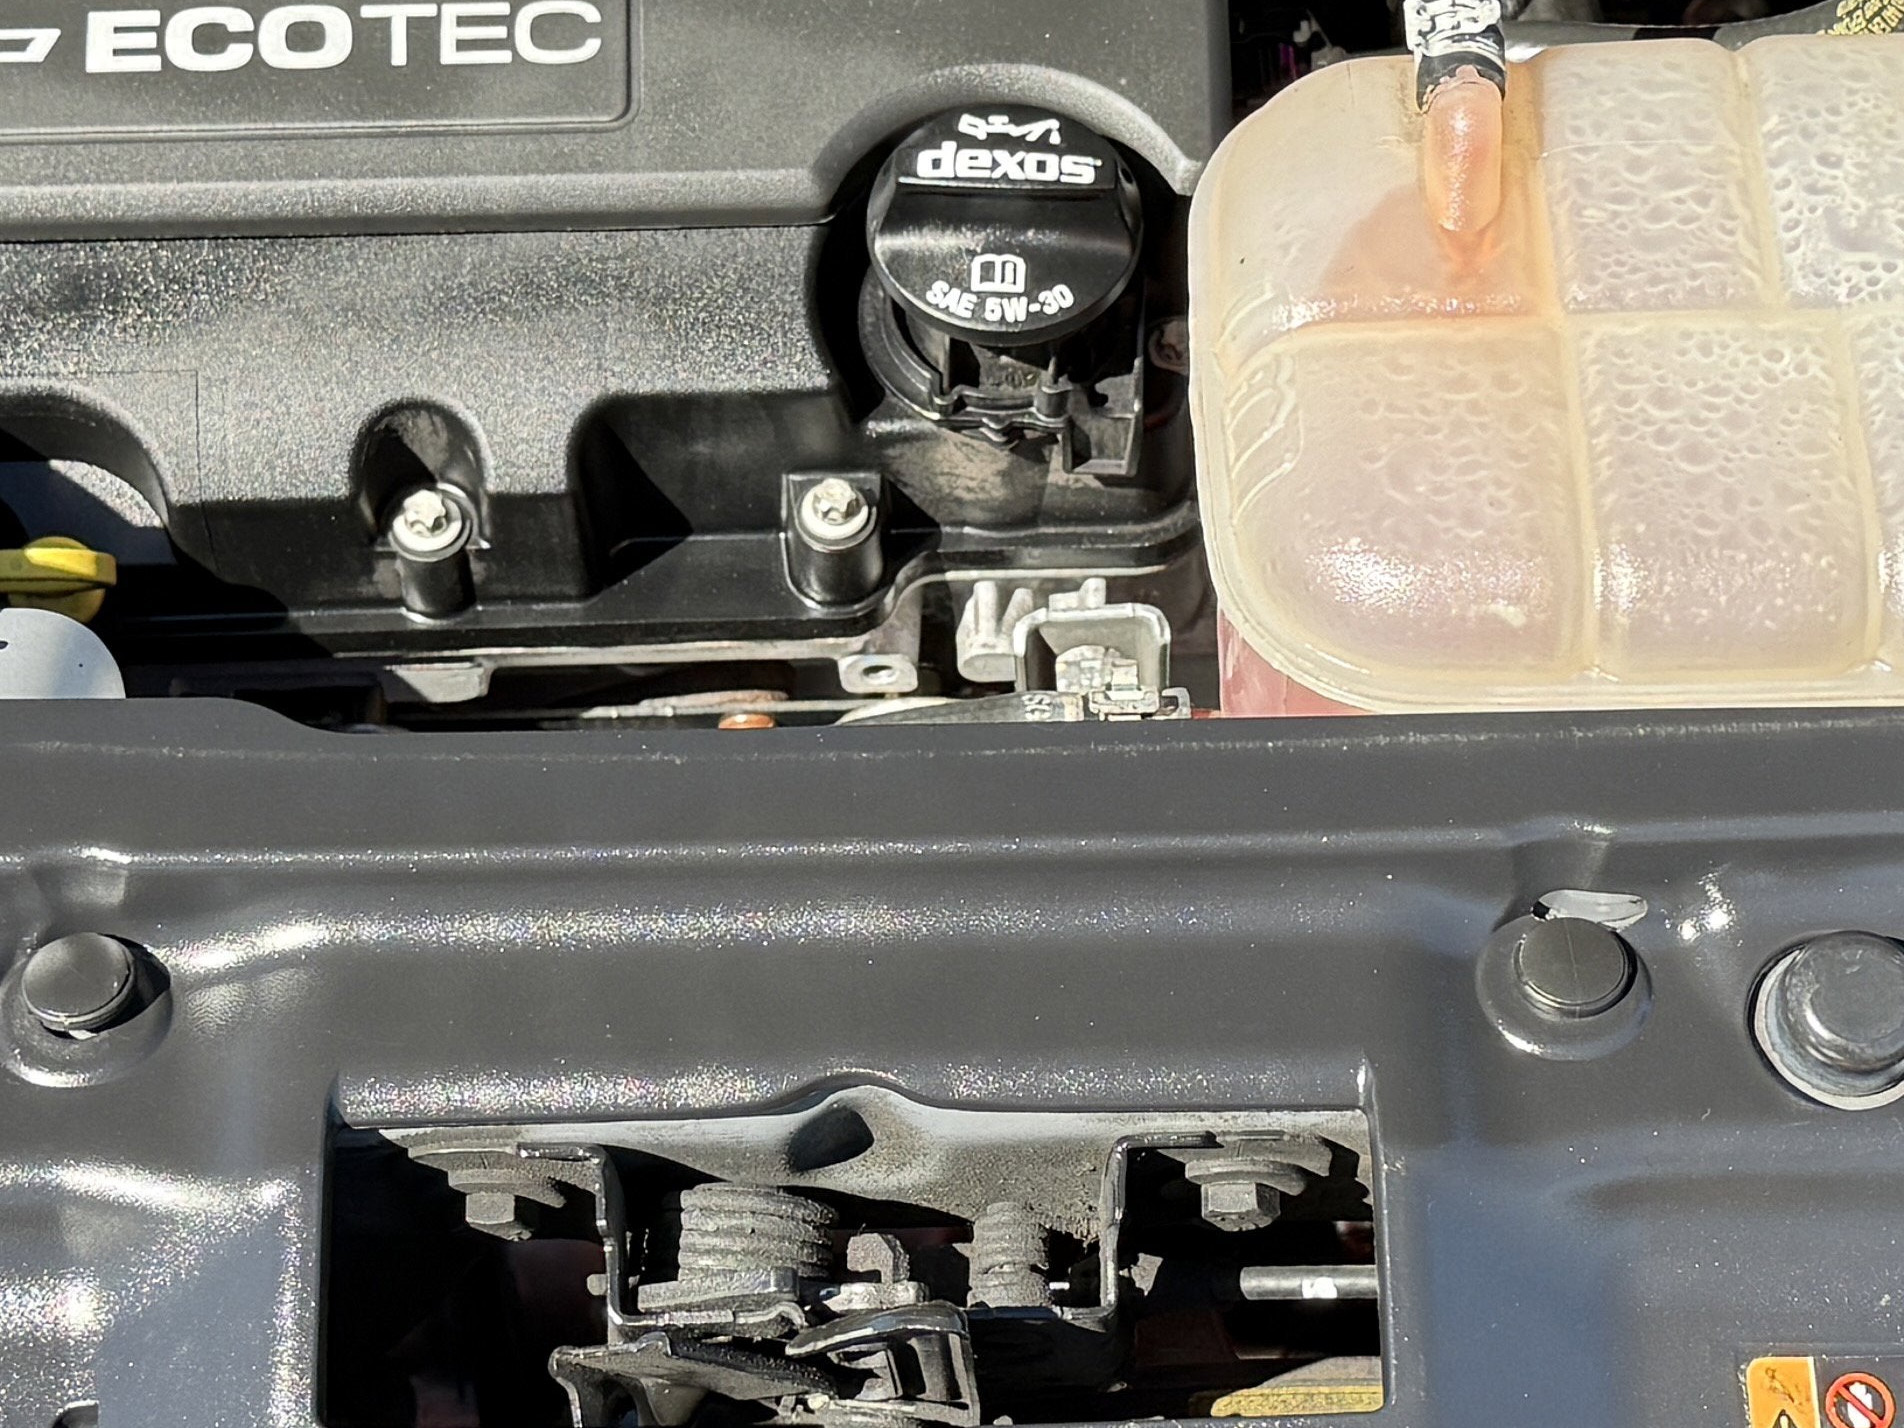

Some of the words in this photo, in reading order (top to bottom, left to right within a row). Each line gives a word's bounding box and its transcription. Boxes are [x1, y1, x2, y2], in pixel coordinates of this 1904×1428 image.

[85, 0, 604, 76] ECOTEC
[916, 140, 1098, 185] dexos
[925, 280, 979, 319] SAE
[984, 283, 1075, 323] 5W-30
